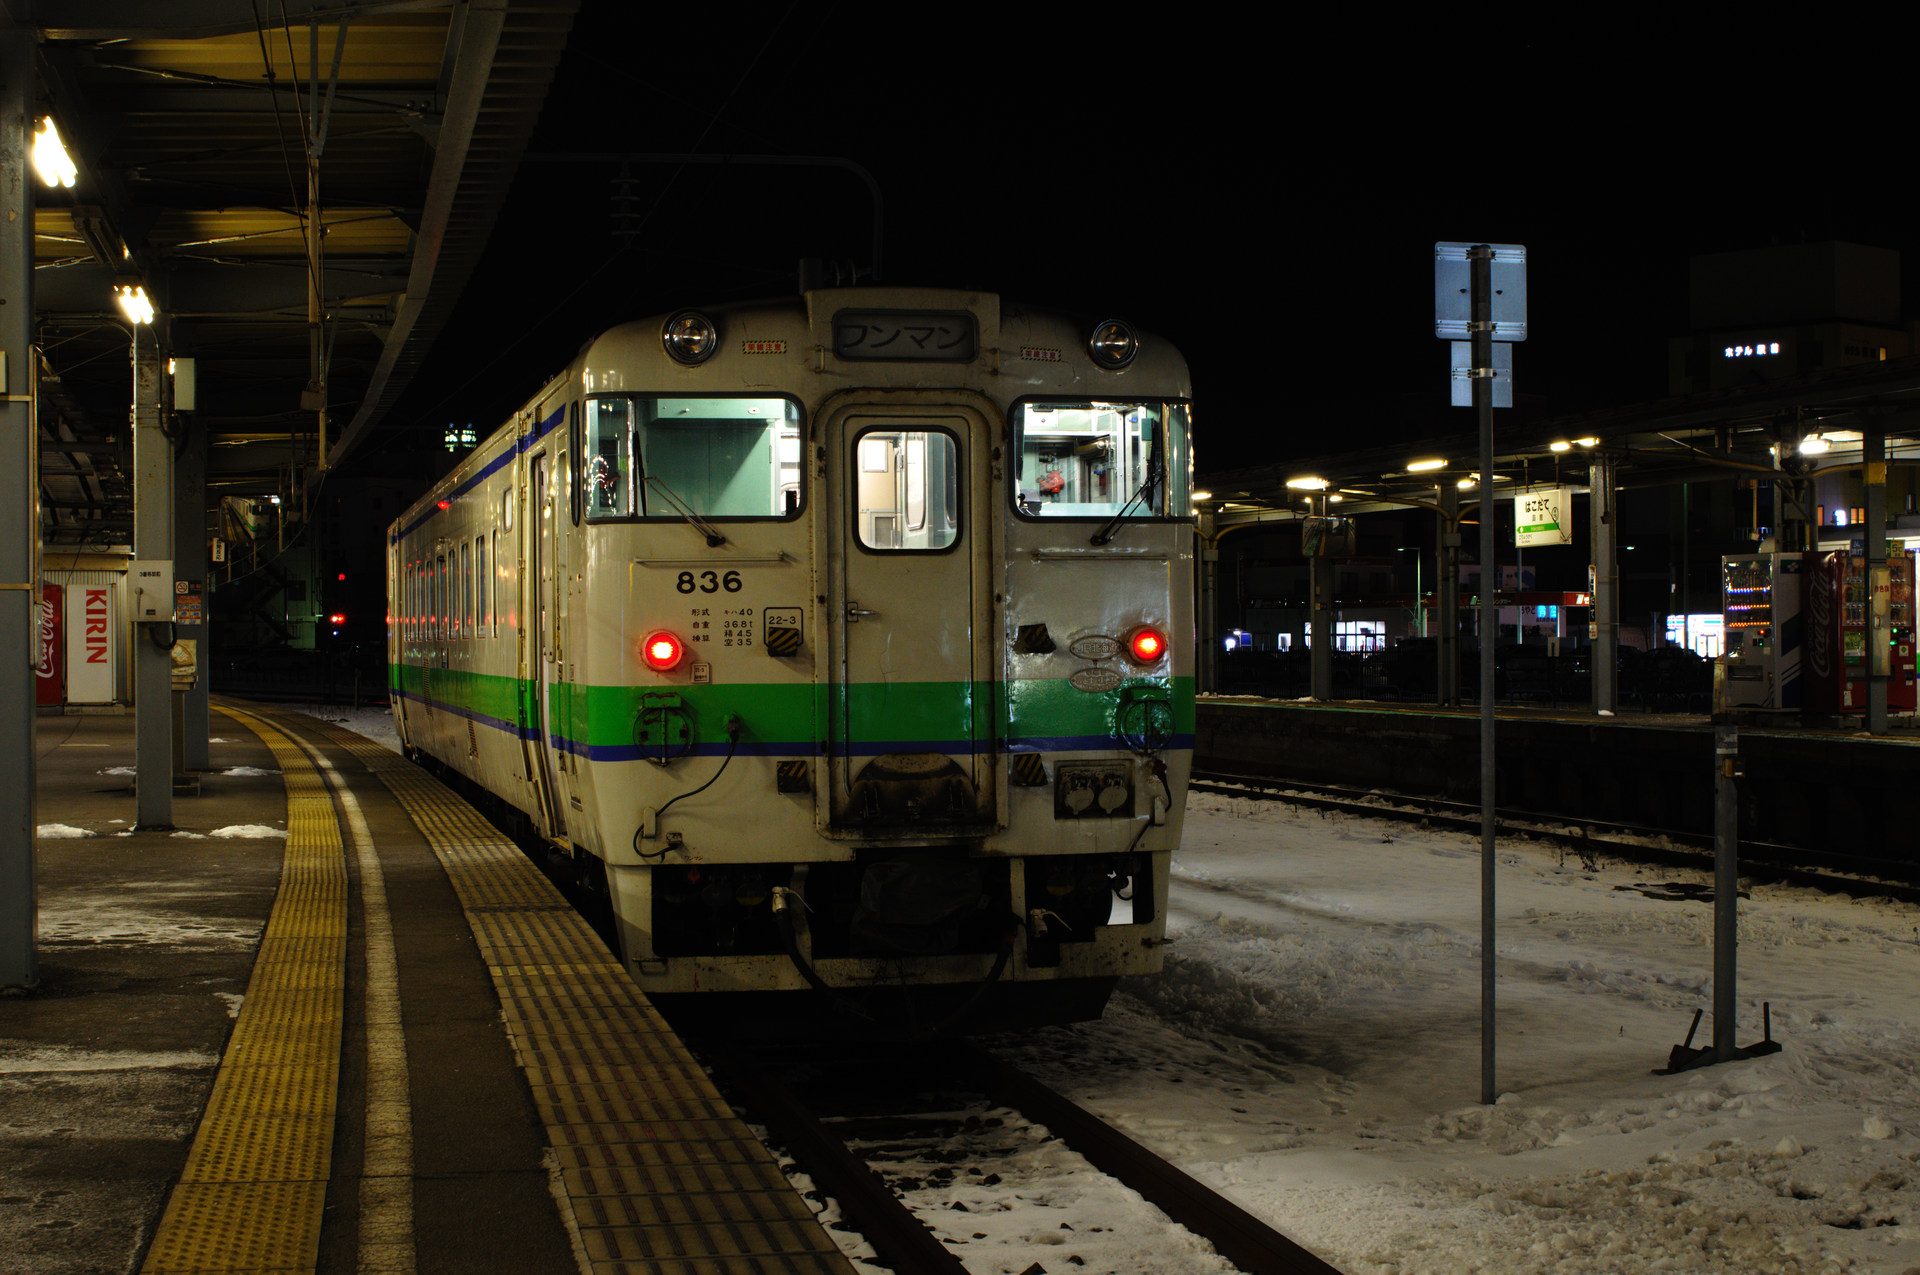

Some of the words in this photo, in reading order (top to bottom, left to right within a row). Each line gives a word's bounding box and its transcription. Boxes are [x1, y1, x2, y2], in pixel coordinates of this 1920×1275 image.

[838, 324, 968, 349] ワンマン
[676, 570, 742, 594] 836
[691, 608, 710, 616] 形式
[692, 621, 710, 629] 自重
[768, 616, 796, 625] 22-3
[86, 589, 107, 663] KIRIN
[737, 629, 752, 637] 4.5
[724, 639, 733, 647] 空
[737, 638, 752, 646] 3.5
